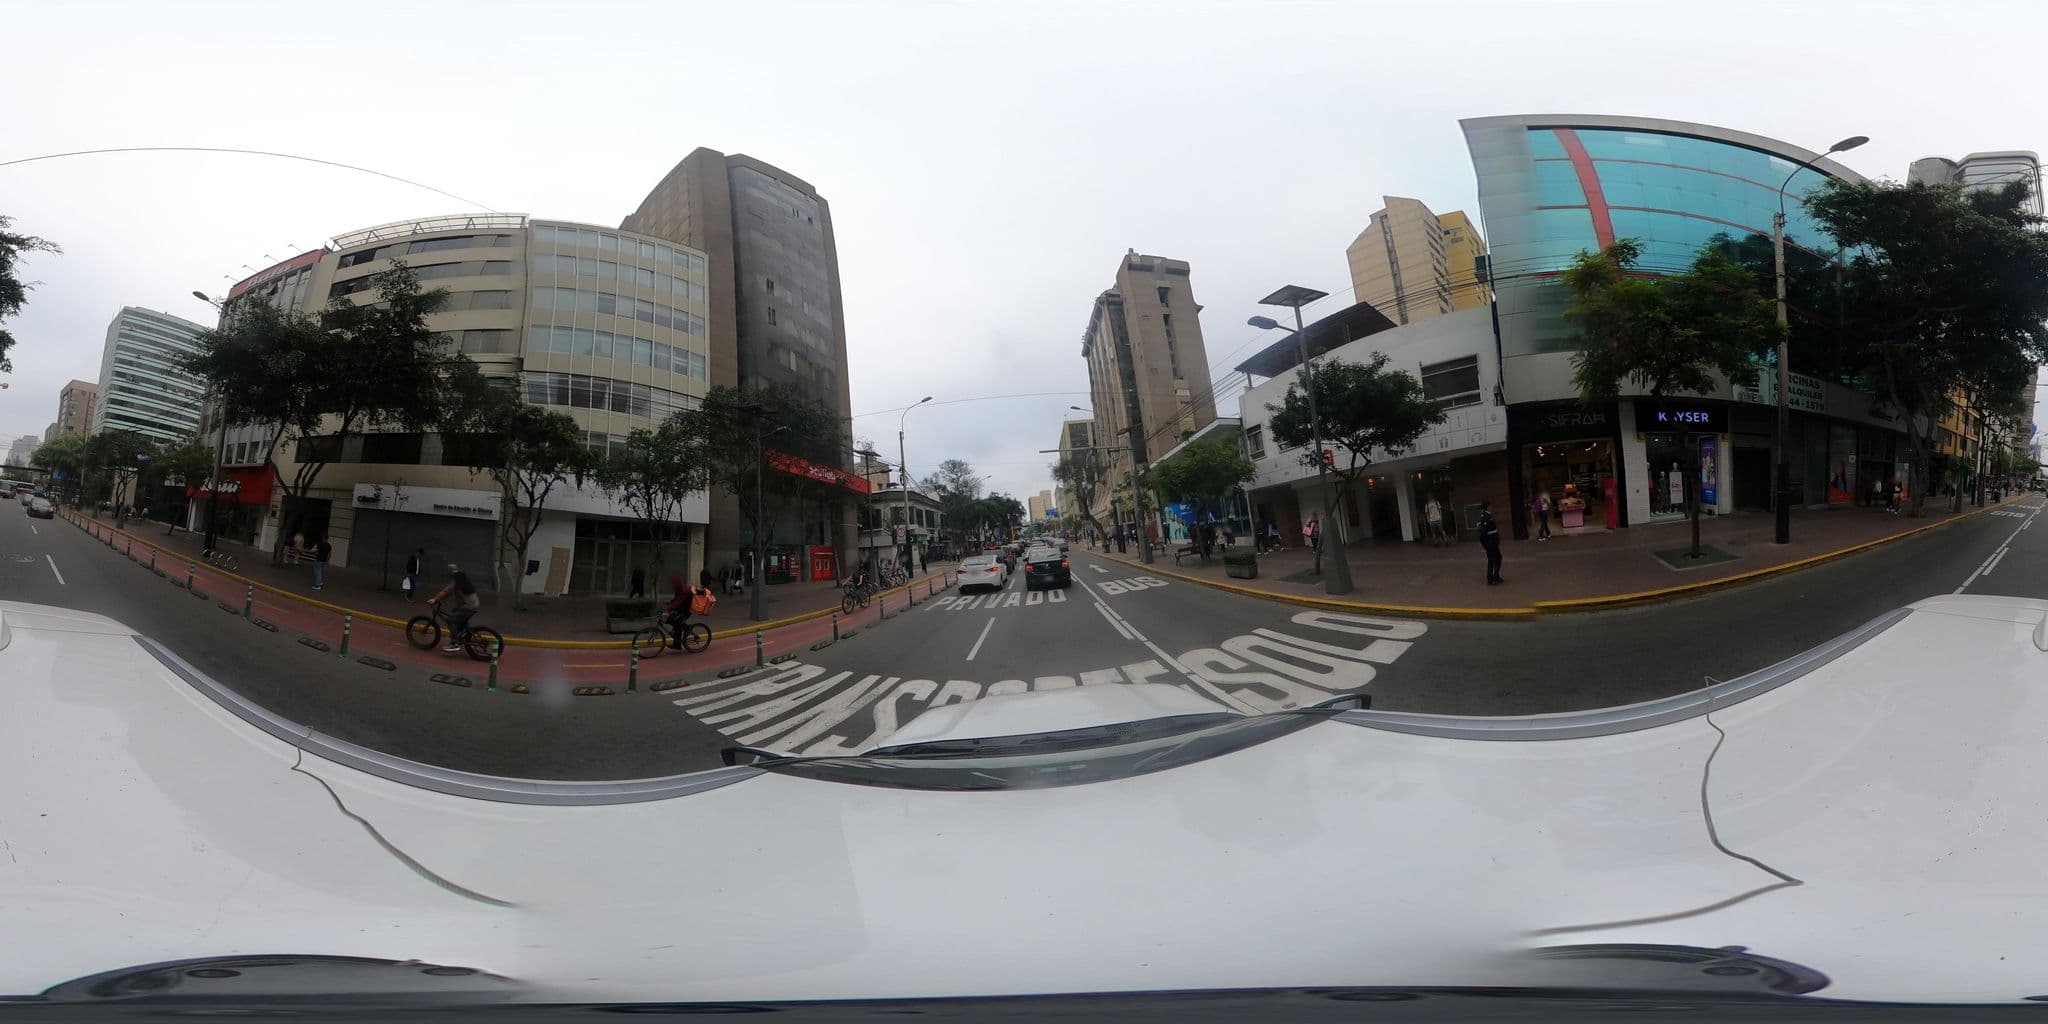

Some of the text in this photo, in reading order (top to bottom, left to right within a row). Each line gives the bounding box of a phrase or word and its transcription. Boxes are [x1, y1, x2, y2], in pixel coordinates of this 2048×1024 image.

[1658, 411, 1709, 423] KYSER
[1097, 576, 1169, 595] BUS
[924, 589, 1067, 611] PRIVADO
[1177, 611, 1428, 715] SOLO
